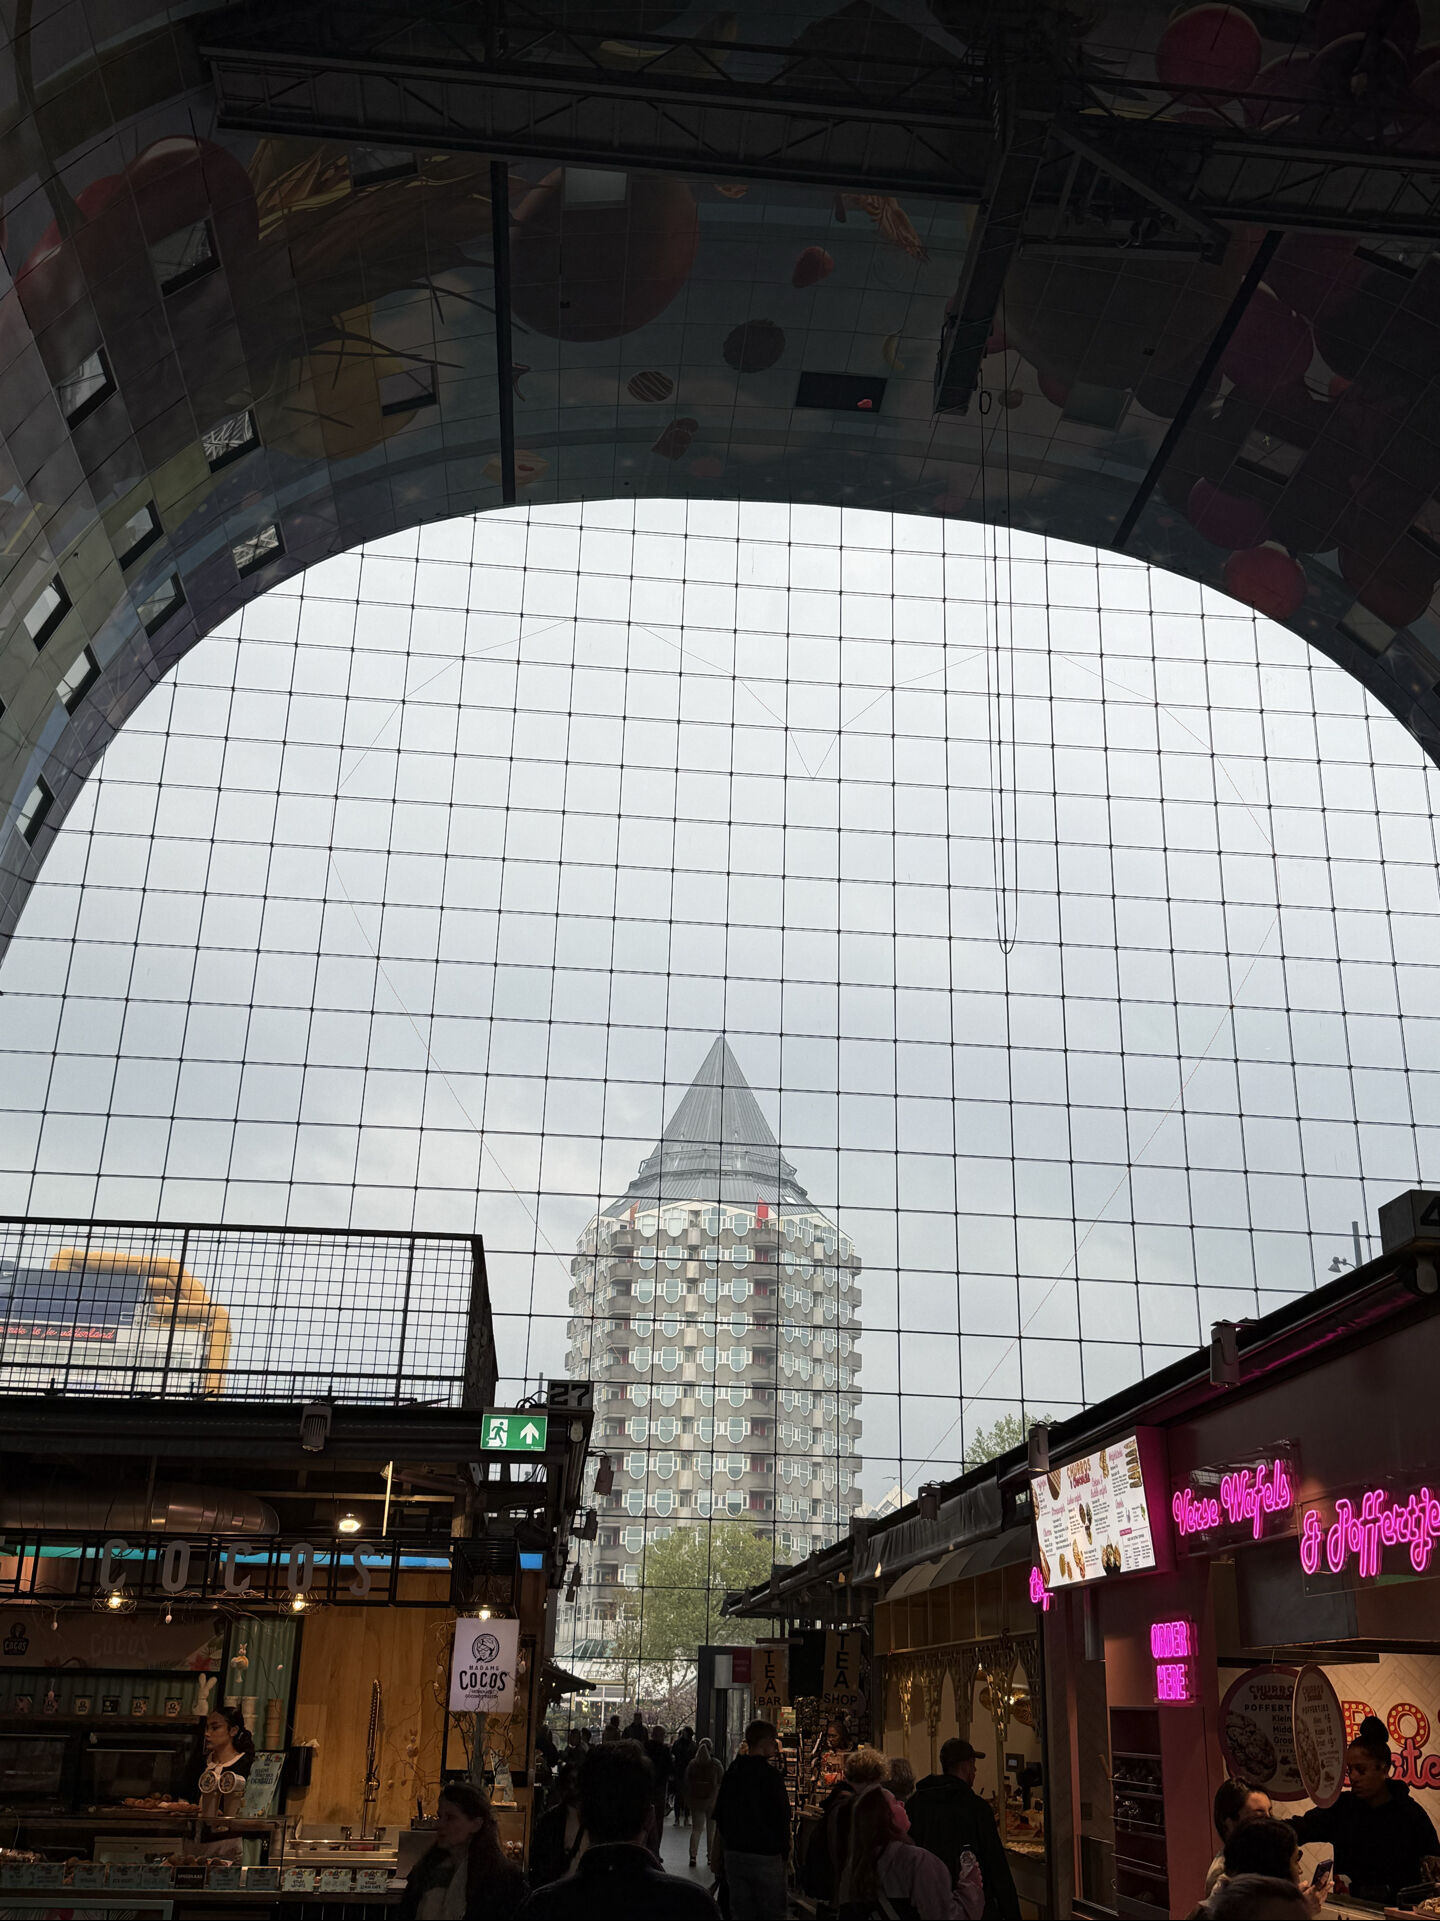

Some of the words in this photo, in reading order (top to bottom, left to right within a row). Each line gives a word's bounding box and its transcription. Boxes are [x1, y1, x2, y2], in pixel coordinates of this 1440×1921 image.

[549, 1383, 590, 1407] 27
[1173, 1488, 1220, 1536] Verse
[1221, 1459, 1290, 1540] Wafels
[98, 1538, 377, 1596] COCOS
[1150, 1620, 1189, 1660] ORDER
[763, 1650, 776, 1693] TEA
[834, 1632, 849, 1689] TEA
[459, 1670, 508, 1691] COCOS
[823, 1692, 858, 1705] SHOP
[1156, 1663, 1188, 1701] HERE
[758, 1696, 781, 1706] BAR
